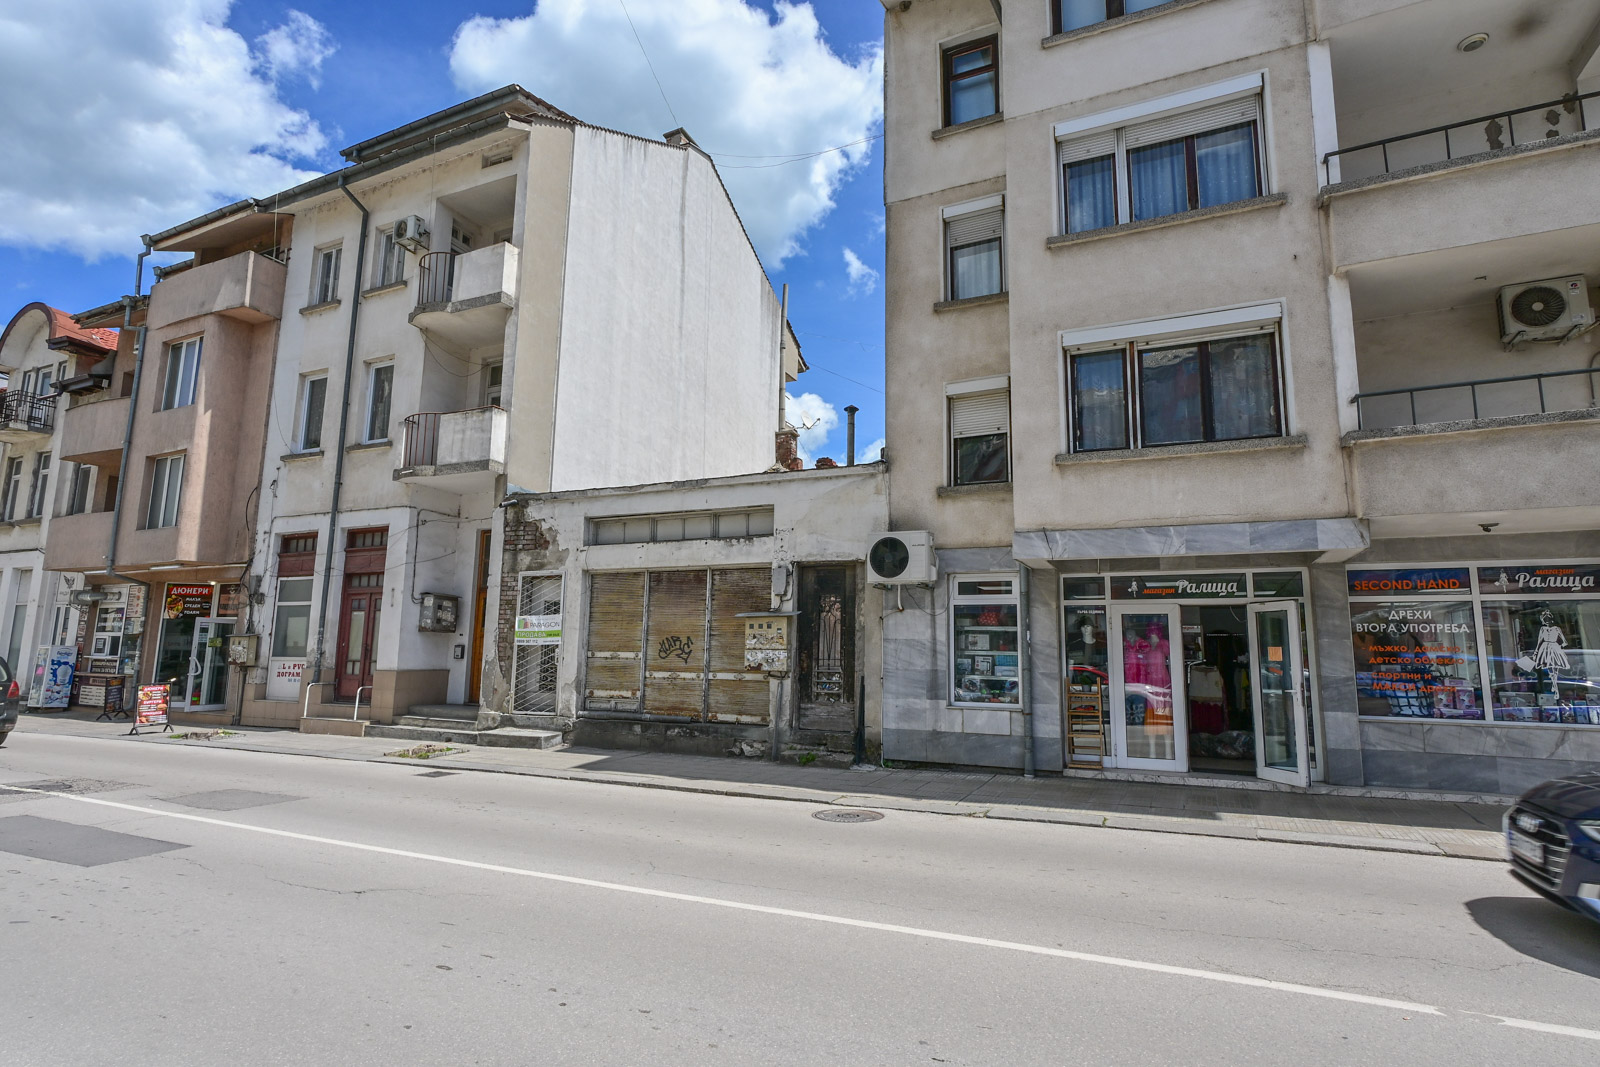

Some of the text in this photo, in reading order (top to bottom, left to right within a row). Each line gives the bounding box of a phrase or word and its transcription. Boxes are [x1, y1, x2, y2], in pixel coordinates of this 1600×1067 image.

[1354, 579, 1460, 590] SECOND HAND
[1515, 572, 1595, 591] Ралица
[1176, 579, 1237, 597] Ралица
[1388, 610, 1432, 621] ДРЕХИ
[1356, 623, 1470, 633] ВТОРА УПОТРЕБА
[1368, 645, 1464, 653] мъжко, дамско,
[1414, 656, 1465, 664] облекло
[1371, 672, 1421, 680] спортни
[1372, 682, 1456, 693] МАКСИ дрехи
